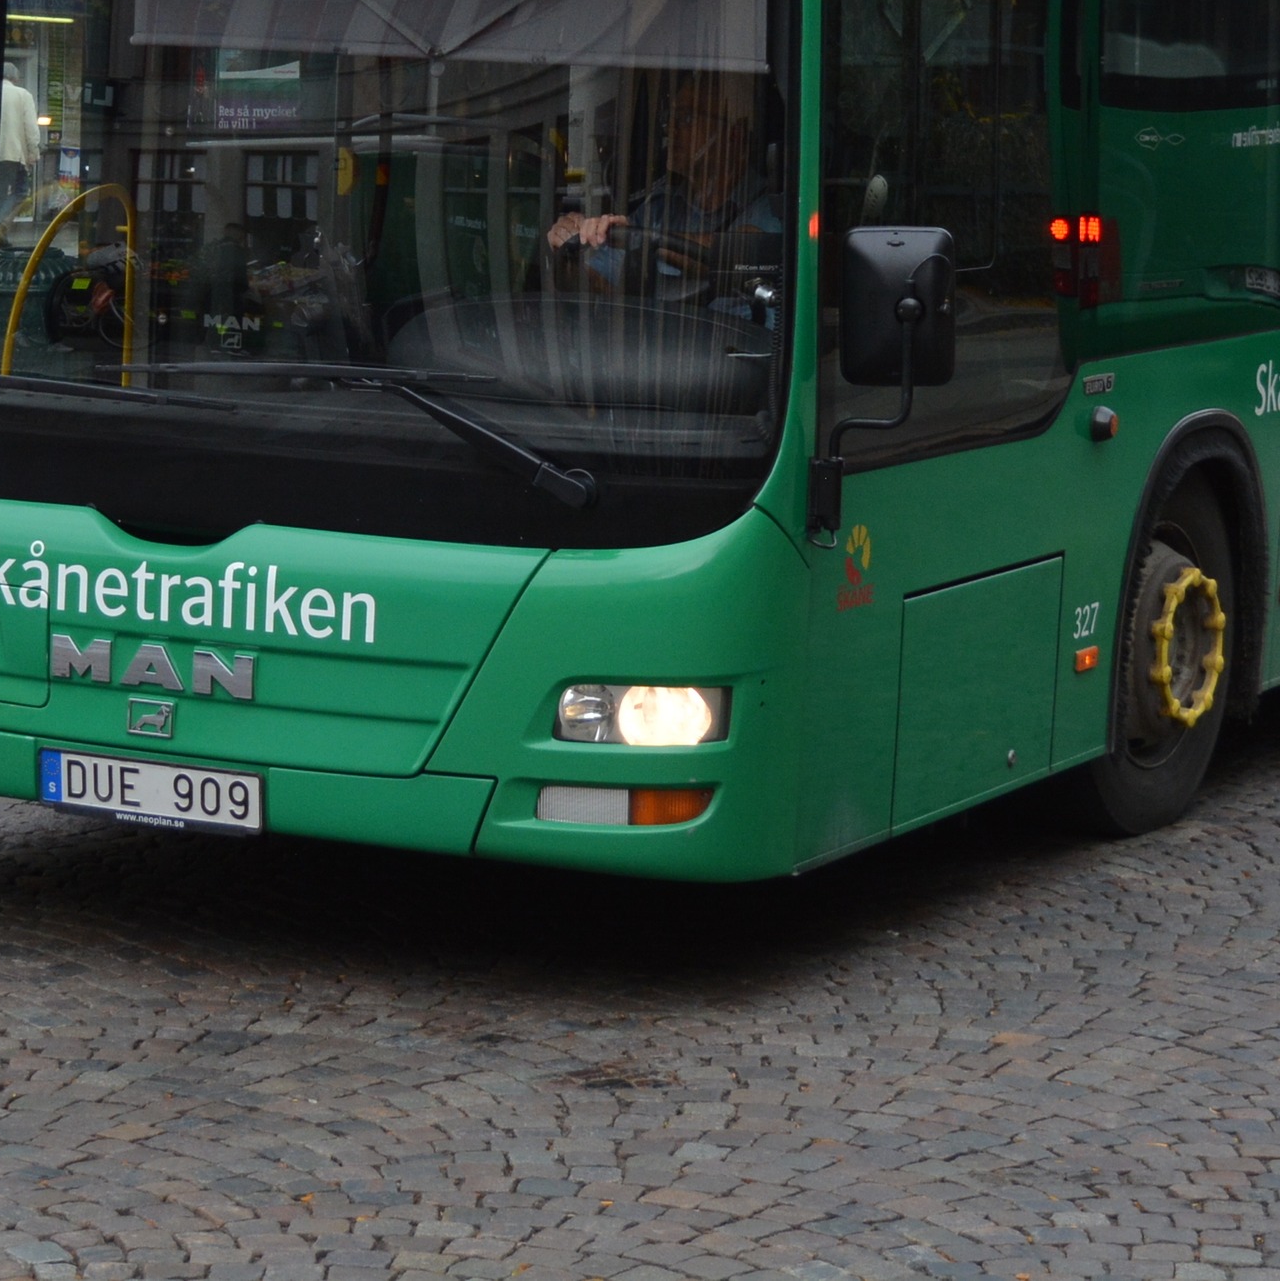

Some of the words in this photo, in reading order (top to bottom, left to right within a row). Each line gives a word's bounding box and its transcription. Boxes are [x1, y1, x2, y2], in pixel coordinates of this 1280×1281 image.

[218, 105, 235, 117] Res
[237, 104, 250, 117] så
[253, 105, 298, 120] mycket
[218, 118, 229, 130] du
[231, 117, 249, 130] vill
[203, 312, 261, 331] MAN
[1105, 375, 1112, 390] 6
[1073, 601, 1100, 639] 327
[51, 633, 255, 701] MAN
[48, 781, 57, 793] S
[66, 758, 142, 808] DUE
[173, 773, 250, 820] 909
[115, 811, 185, 828] www.neoplan.se
